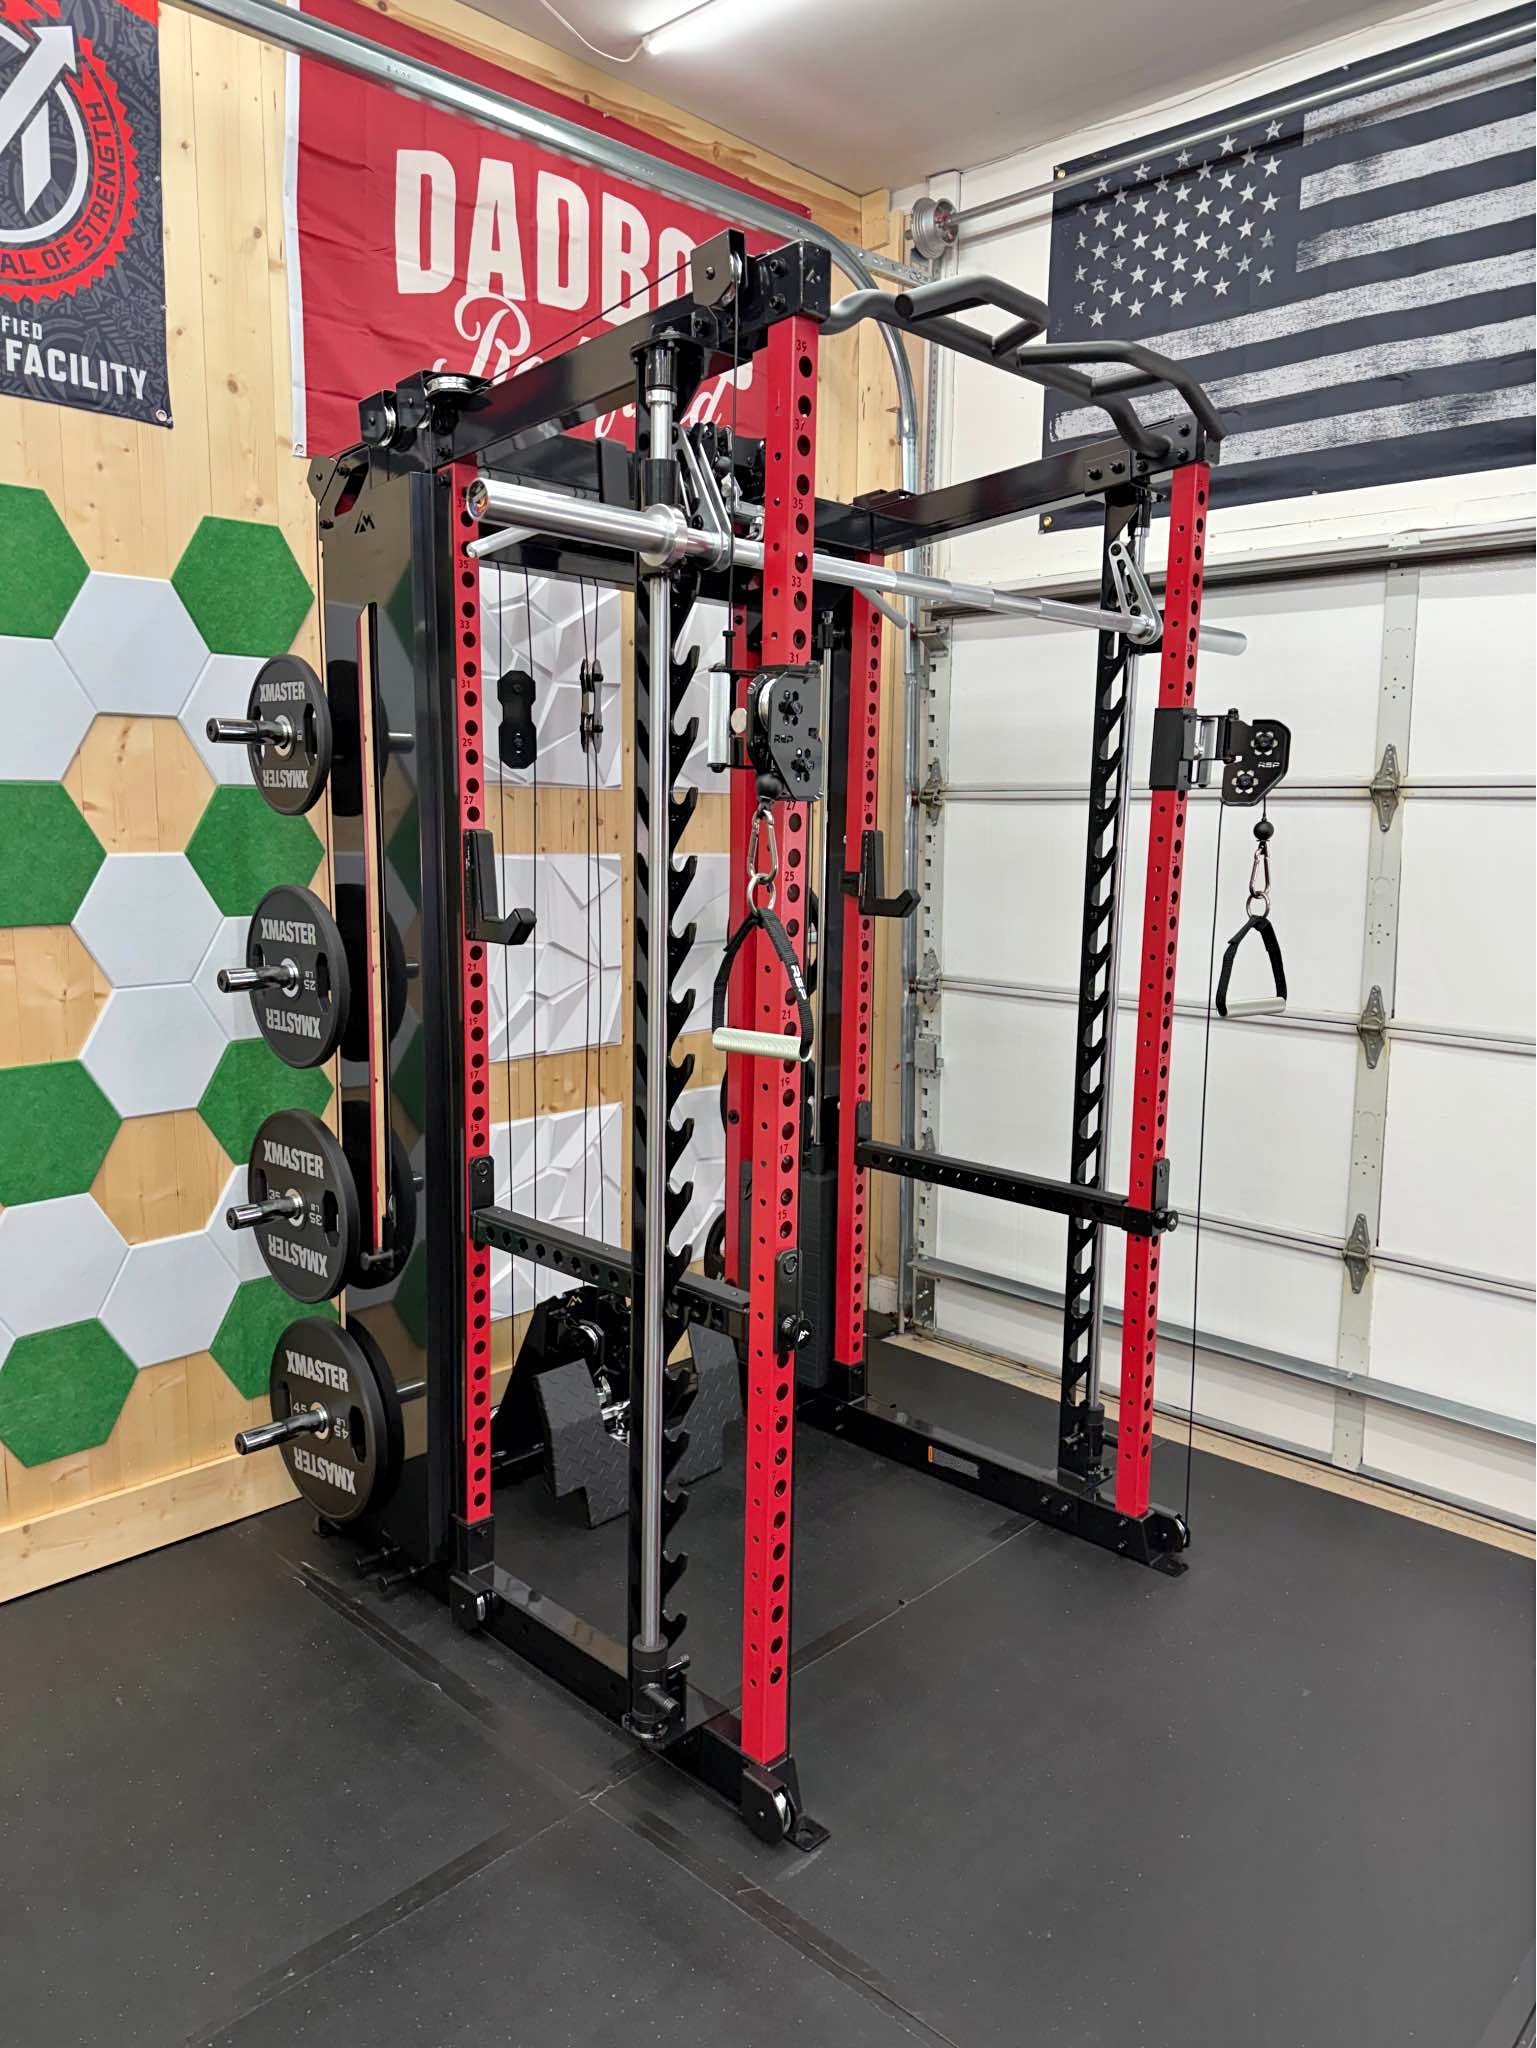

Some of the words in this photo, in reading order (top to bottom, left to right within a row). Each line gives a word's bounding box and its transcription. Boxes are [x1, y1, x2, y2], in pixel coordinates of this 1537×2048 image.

[41, 241, 73, 270] OF
[73, 102, 117, 250] STRENGTH
[1, 315, 43, 340] FIED
[796, 339, 807, 352] 39
[5, 338, 147, 400] FACILITY
[793, 497, 804, 510] 35
[459, 560, 469, 568] 35
[791, 575, 802, 588] 33
[460, 620, 470, 630] 33
[789, 651, 799, 664] 31
[461, 680, 470, 688] 31
[259, 681, 305, 702] XMASTER
[262, 769, 308, 789] XMASTER
[464, 795, 474, 805] 27
[786, 799, 797, 811] 27
[784, 871, 795, 882] 25
[260, 918, 317, 946] XMASTER
[303, 979, 316, 991] 25
[781, 1009, 791, 1020] 21
[265, 1007, 321, 1039] XMASTER
[470, 1070, 479, 1079] 17
[780, 1076, 790, 1088] 19
[471, 1124, 480, 1132] 15
[780, 1143, 789, 1154] 17
[263, 1139, 324, 1179] XMASTER
[309, 1212, 322, 1226] 35
[778, 1209, 788, 1220] 15
[268, 1233, 328, 1278] XMASTER
[285, 1350, 349, 1392] XMASTER
[293, 1402, 307, 1414] 45
[335, 1425, 349, 1439] 45
[293, 1446, 357, 1495] XMASTER
